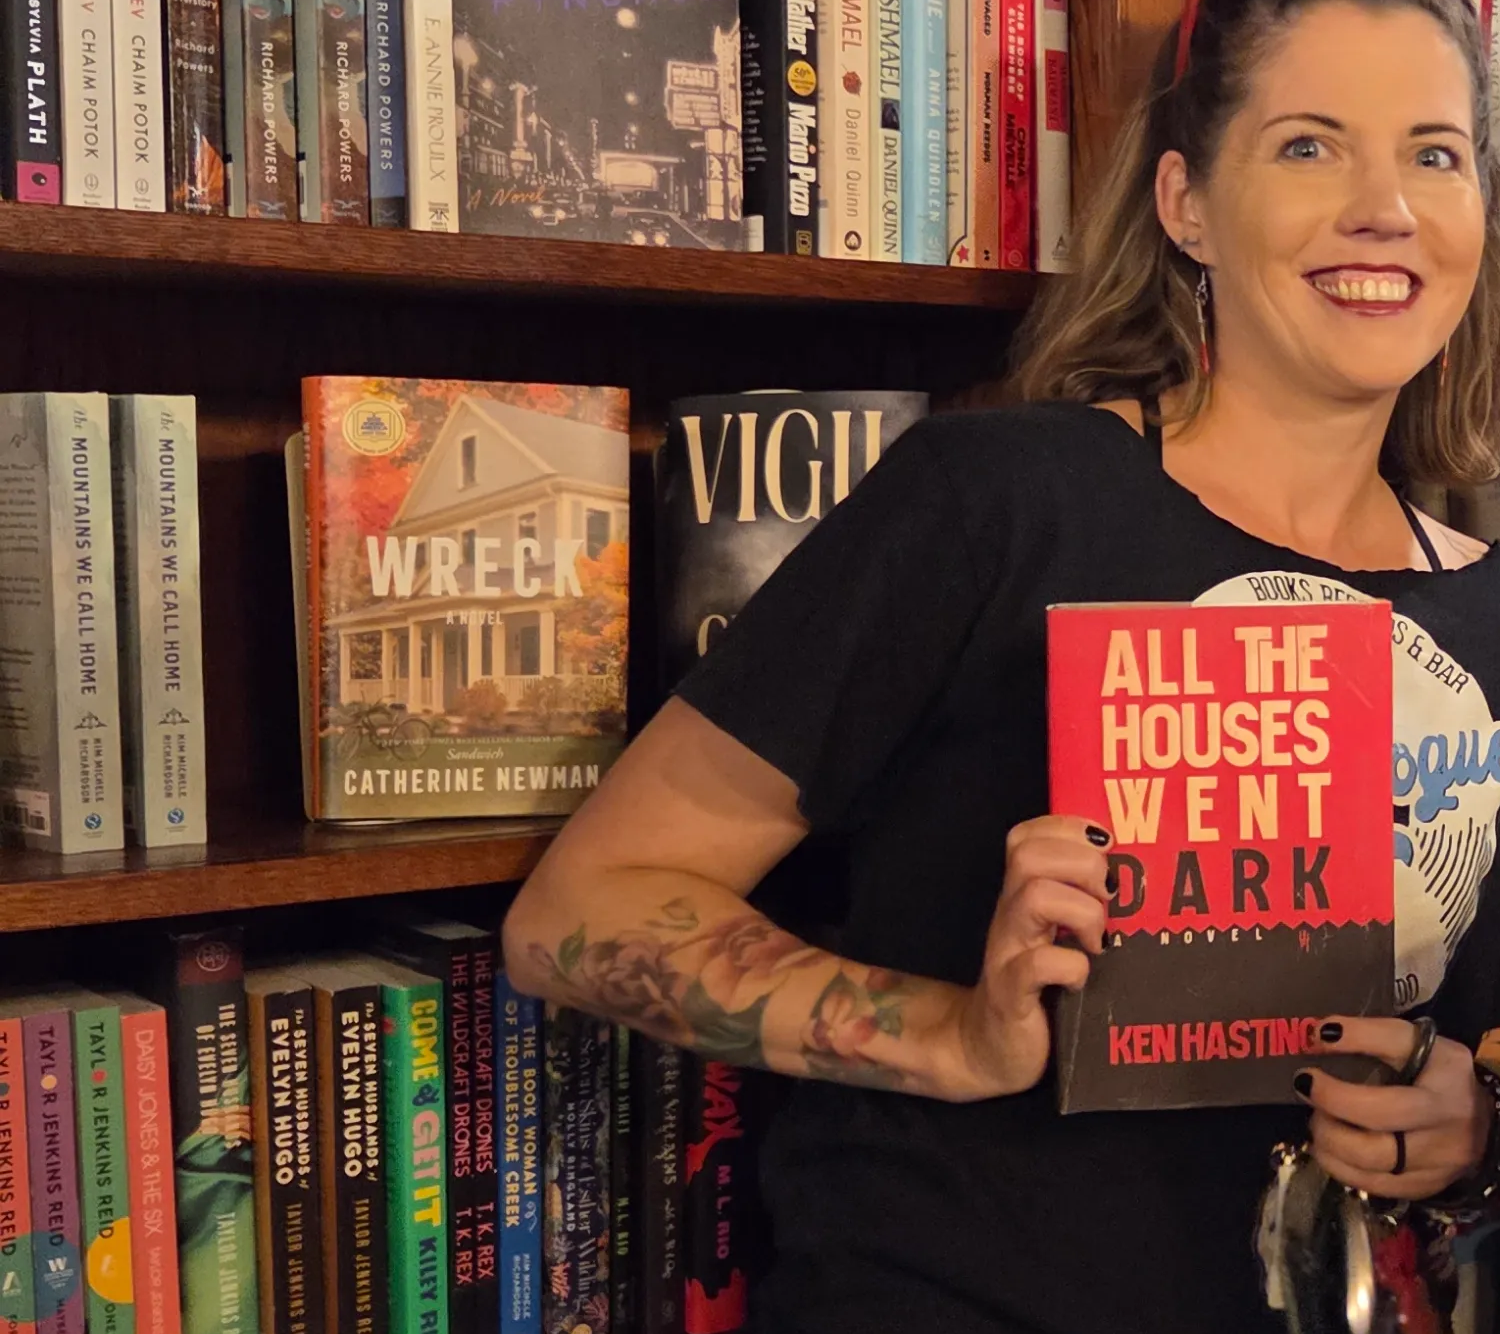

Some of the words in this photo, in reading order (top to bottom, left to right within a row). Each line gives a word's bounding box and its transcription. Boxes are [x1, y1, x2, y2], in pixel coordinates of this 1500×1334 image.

[175, 38, 215, 55] Richard
[375, 1, 391, 87] RICHARD
[423, 17, 440, 33] E.
[81, 28, 97, 89] CHAIM
[177, 58, 214, 74] Powers
[260, 41, 275, 113] RICHARD
[425, 37, 443, 105] ANNIE
[27, 60, 48, 144] PLATH
[83, 96, 100, 159] POTOK
[788, 101, 817, 162] Mario
[263, 119, 278, 184] POWERS
[379, 95, 393, 171] POWERS
[428, 109, 446, 182] PROULX
[844, 108, 862, 162] Daniel
[789, 164, 817, 217] Puzo
[846, 168, 862, 217] Quinn
[883, 135, 900, 193] DANIEL
[883, 196, 900, 256] QUINN
[71, 436, 91, 550] MOUNTAINS
[75, 556, 93, 586] WE
[366, 534, 587, 600] WRECK
[1246, 576, 1314, 603] BOOKS
[77, 591, 95, 637] CALL
[78, 642, 97, 696] HOME
[1100, 628, 1215, 698] ALL
[1234, 624, 1330, 695] THE
[1407, 634, 1426, 662] &
[1425, 651, 1470, 695] BAR
[446, 746, 505, 762] Sandwich
[1102, 698, 1332, 772] HOUSES
[343, 767, 486, 797] CATHERINE
[496, 764, 600, 794] NEWMAN
[1105, 772, 1332, 846] WENT
[1107, 845, 1332, 919] DARK
[473, 950, 492, 984] THE
[410, 998, 440, 1082] COME
[474, 988, 494, 1094] WILDCRAFT
[505, 1000, 518, 1027] OF
[523, 1025, 536, 1059] THE
[1108, 1023, 1177, 1066] KEN
[1181, 1017, 1320, 1063] HASTING
[135, 1029, 157, 1083] DAISY
[270, 1016, 292, 1109] EVELYN
[138, 1087, 161, 1148] JONES
[411, 1083, 440, 1107] &
[505, 1033, 520, 1163] TROUBLESOME
[523, 1067, 536, 1118] BOOK
[140, 1151, 161, 1169] &
[275, 1114, 295, 1186] HUGO
[411, 1109, 442, 1180] GET
[475, 1097, 495, 1174] DRONES
[524, 1125, 538, 1195] WOMAN
[142, 1169, 163, 1205] THE
[413, 1184, 442, 1228] IT
[505, 1170, 521, 1228] CREEK
[144, 1207, 164, 1238] SIX
[418, 1234, 439, 1302] KILEY
